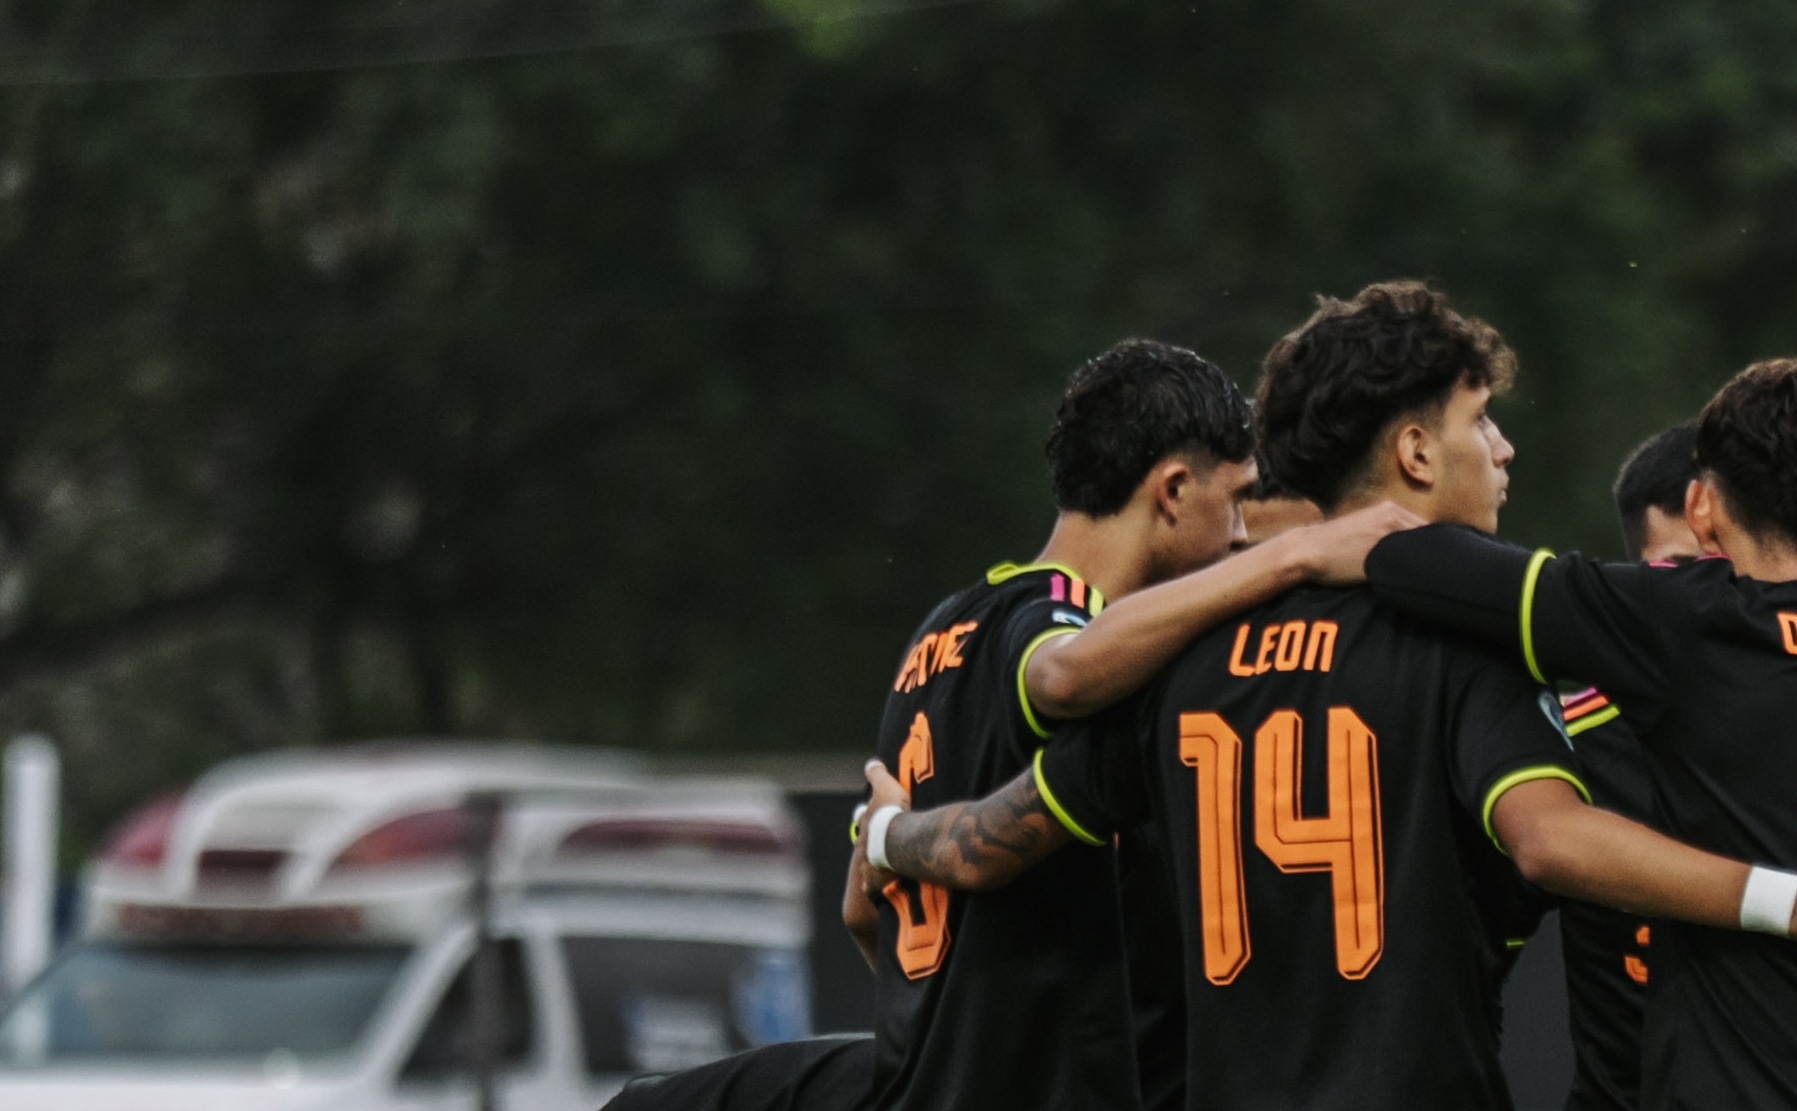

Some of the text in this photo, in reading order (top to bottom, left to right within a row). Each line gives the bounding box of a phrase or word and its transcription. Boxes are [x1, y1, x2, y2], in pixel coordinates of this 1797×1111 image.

[1228, 620, 1339, 677] LEON
[881, 711, 950, 980] 6
[1178, 706, 1384, 987] 14
